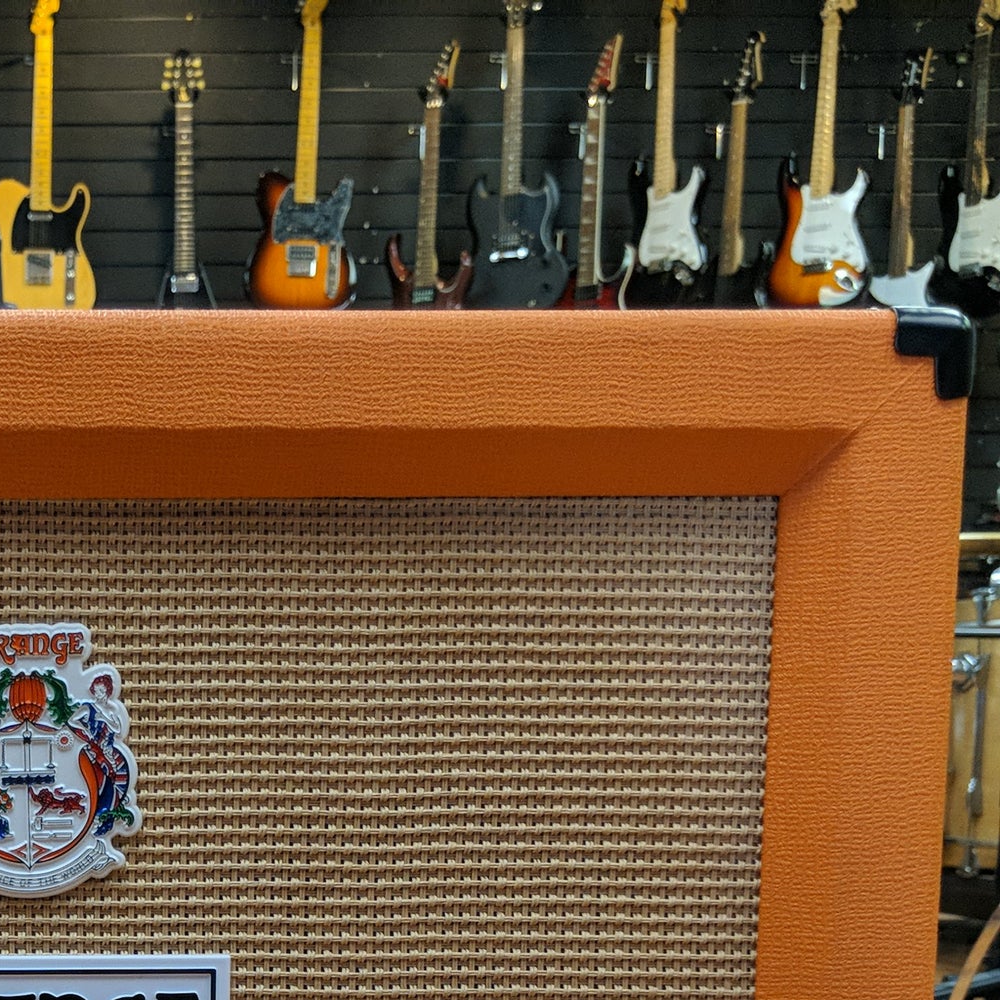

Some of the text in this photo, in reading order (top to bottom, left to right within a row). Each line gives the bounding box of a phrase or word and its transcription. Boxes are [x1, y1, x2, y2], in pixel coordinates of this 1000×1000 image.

[20, 878, 32, 888] OF
[38, 874, 57, 886] THE
[61, 854, 94, 880] WORLD
